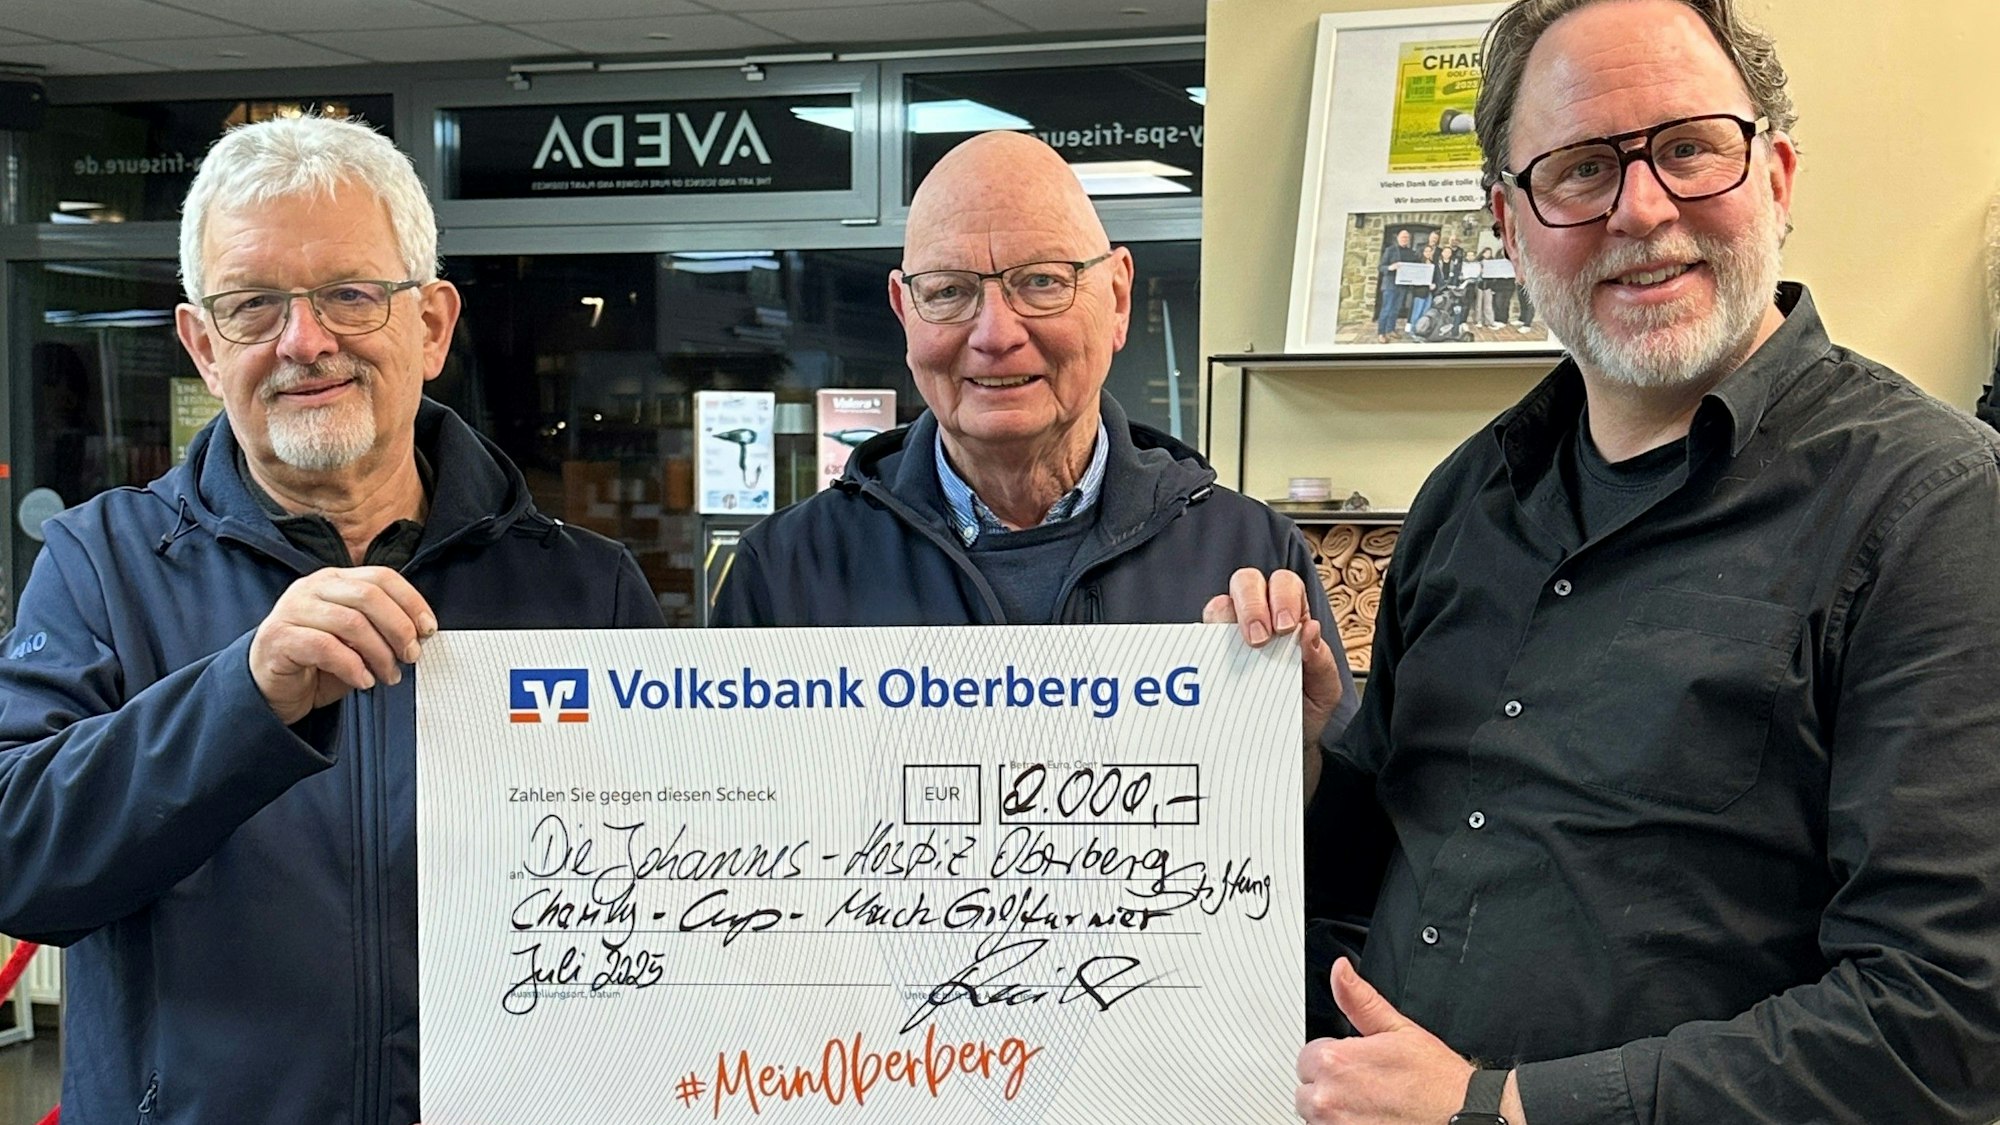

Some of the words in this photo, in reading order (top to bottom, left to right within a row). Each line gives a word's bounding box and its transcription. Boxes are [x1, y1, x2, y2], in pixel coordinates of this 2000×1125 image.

[1406, 180, 1426, 188] Dank
[1428, 179, 1440, 187] für
[1441, 179, 1453, 187] die
[1455, 178, 1473, 186] tolle
[1410, 196, 1443, 204] konnten
[608, 667, 865, 709] Volksbank
[878, 666, 1119, 718] Oberberg
[1134, 667, 1200, 707] eG
[508, 787, 565, 803] Zahlen
[570, 787, 595, 802] Sie
[600, 790, 653, 806] gegen
[657, 787, 712, 802] diesen
[716, 787, 777, 802] Scheck
[924, 786, 960, 801] EUR
[524, 814, 599, 877] Die
[991, 826, 1172, 892] Oberberg
[509, 870, 524, 880] an
[502, 943, 586, 1015] Juli
[592, 949, 665, 991] 2025
[589, 989, 620, 999] Datum
